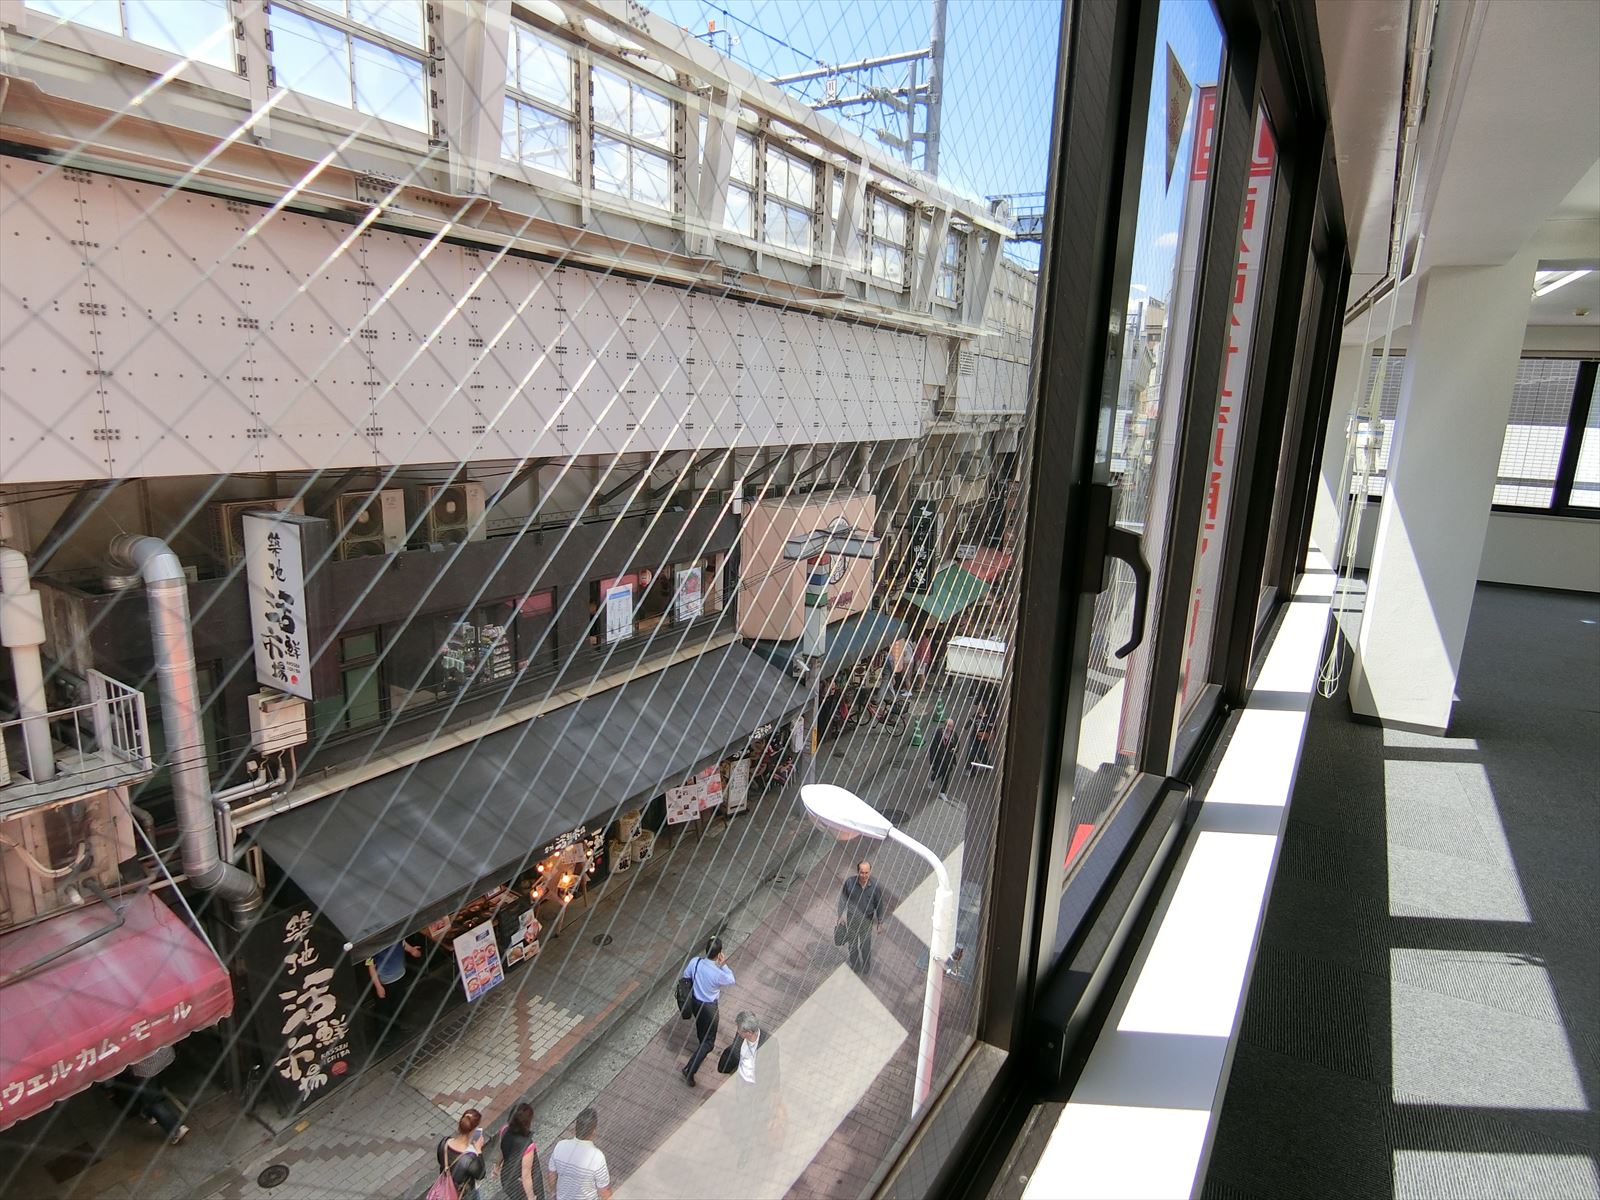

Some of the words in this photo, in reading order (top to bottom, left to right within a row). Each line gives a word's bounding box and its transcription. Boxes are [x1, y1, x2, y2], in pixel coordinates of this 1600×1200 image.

[0, 1001, 193, 1111] ウェルカム・モール
